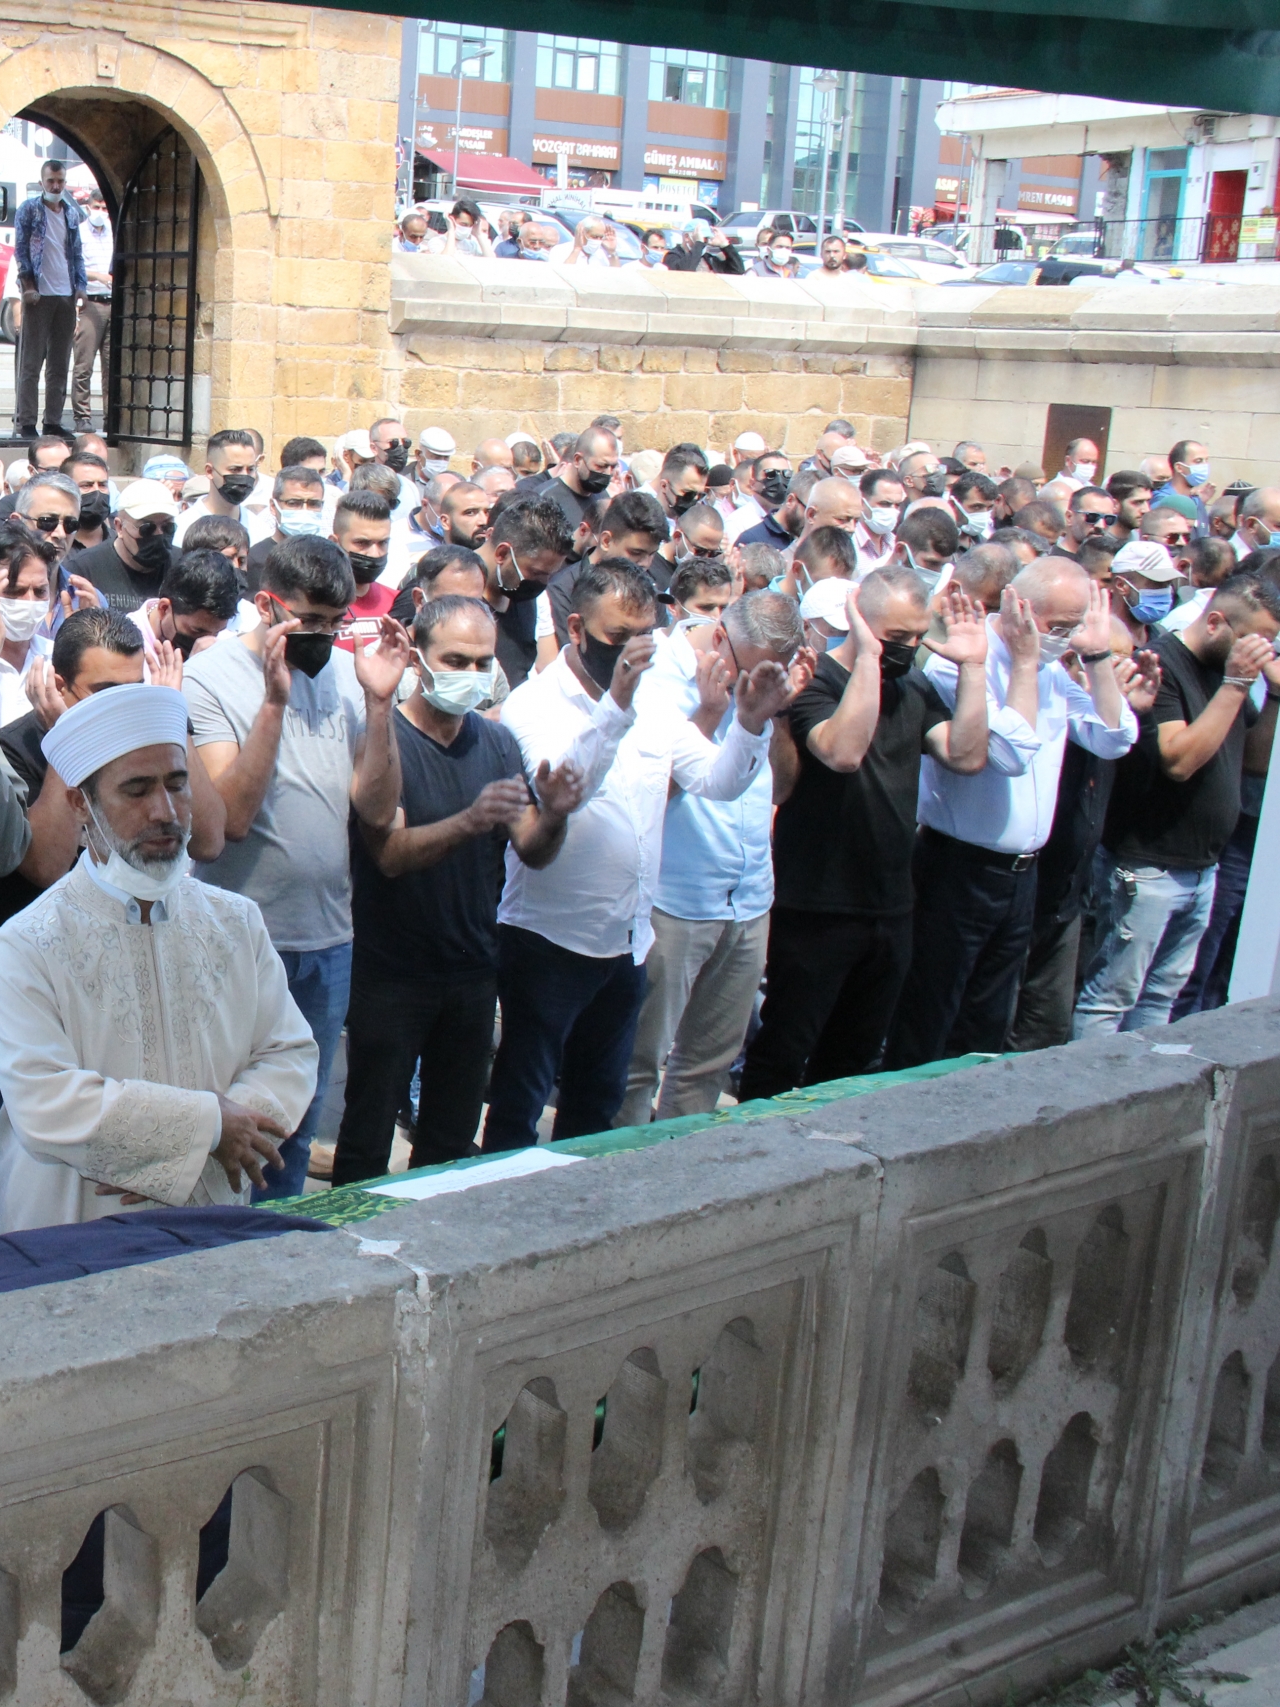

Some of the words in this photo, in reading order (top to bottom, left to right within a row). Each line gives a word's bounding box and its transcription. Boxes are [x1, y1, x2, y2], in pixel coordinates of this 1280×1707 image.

[532, 138, 576, 155] YOZGAT
[644, 149, 677, 169] GÜNEŞ
[678, 156, 724, 173] AMBALAJ
